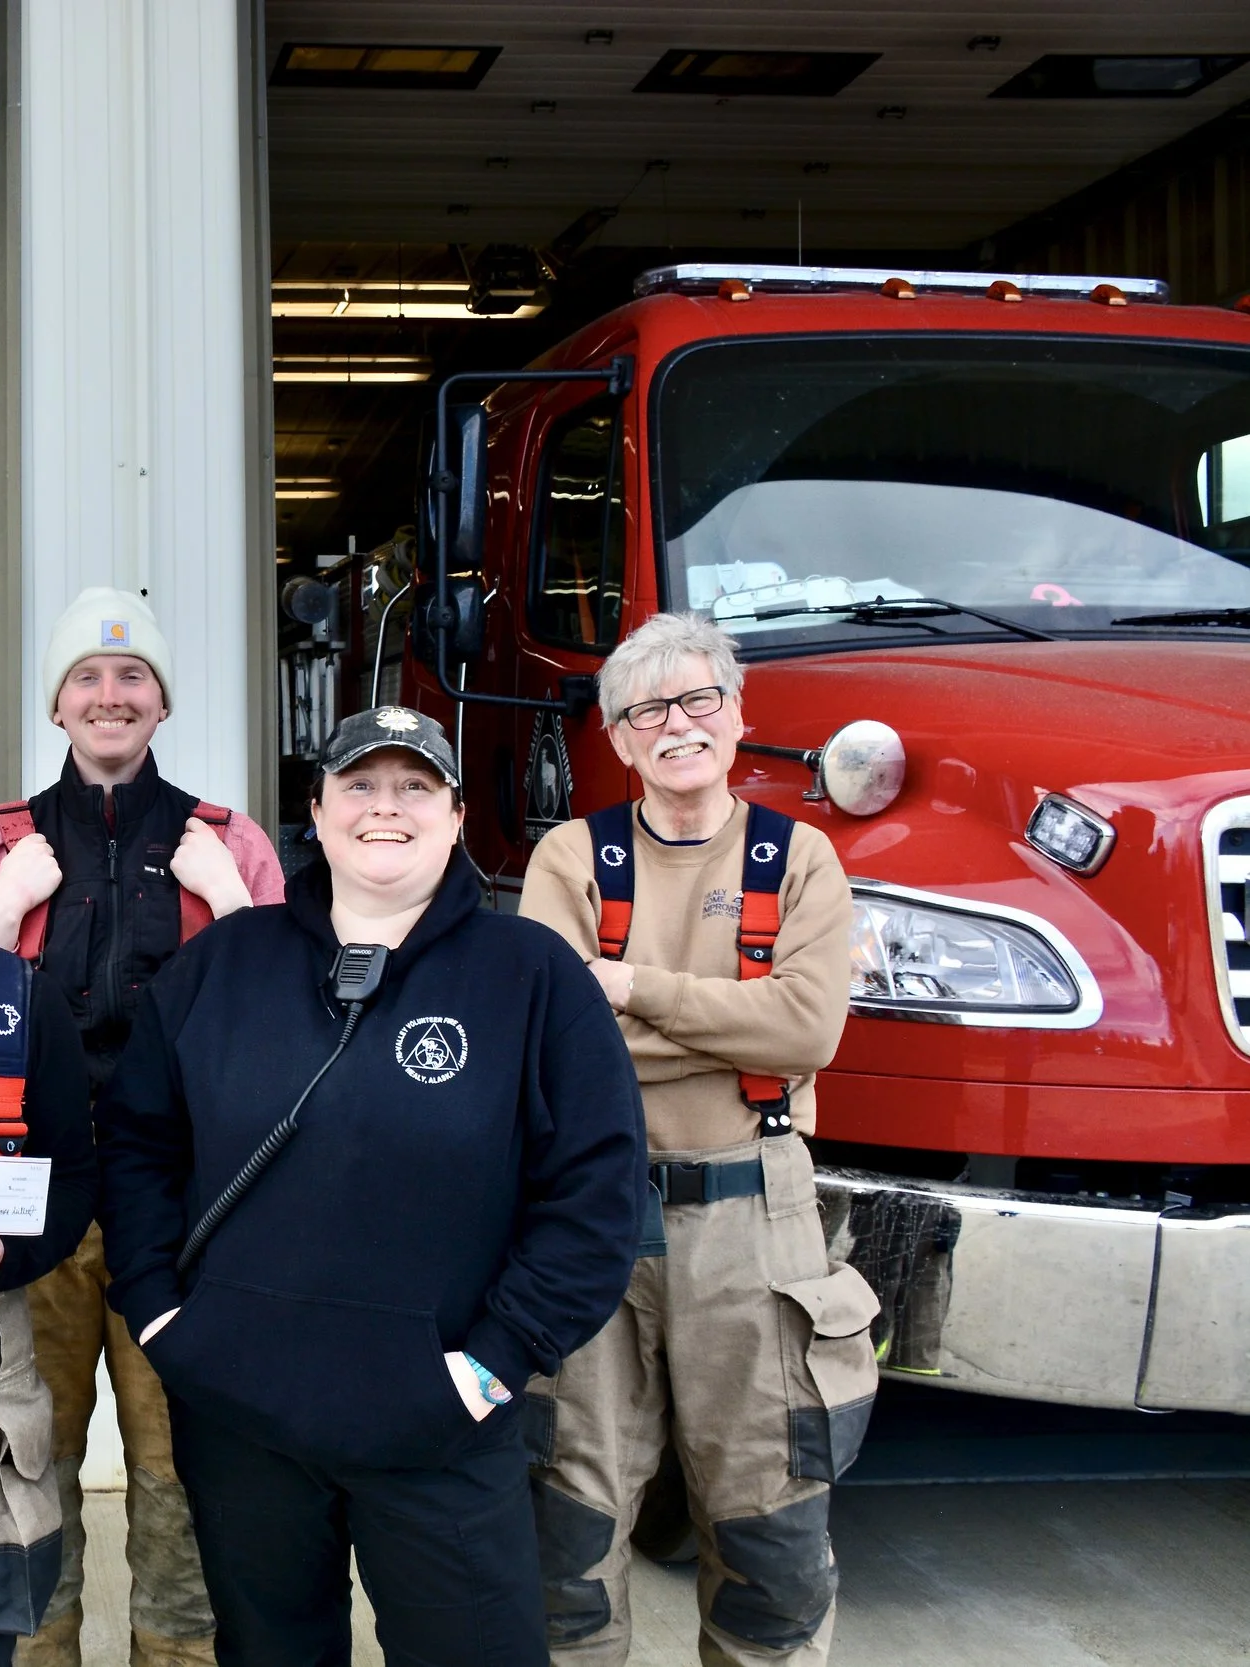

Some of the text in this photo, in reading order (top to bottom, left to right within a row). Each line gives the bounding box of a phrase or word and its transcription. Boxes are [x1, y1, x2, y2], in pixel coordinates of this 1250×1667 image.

[405, 1016, 443, 1030] VOLUNTEER
[443, 1017, 459, 1027] FIRE
[455, 1023, 469, 1069] DEPARTMENT
[428, 1071, 456, 1084] ALASKA
